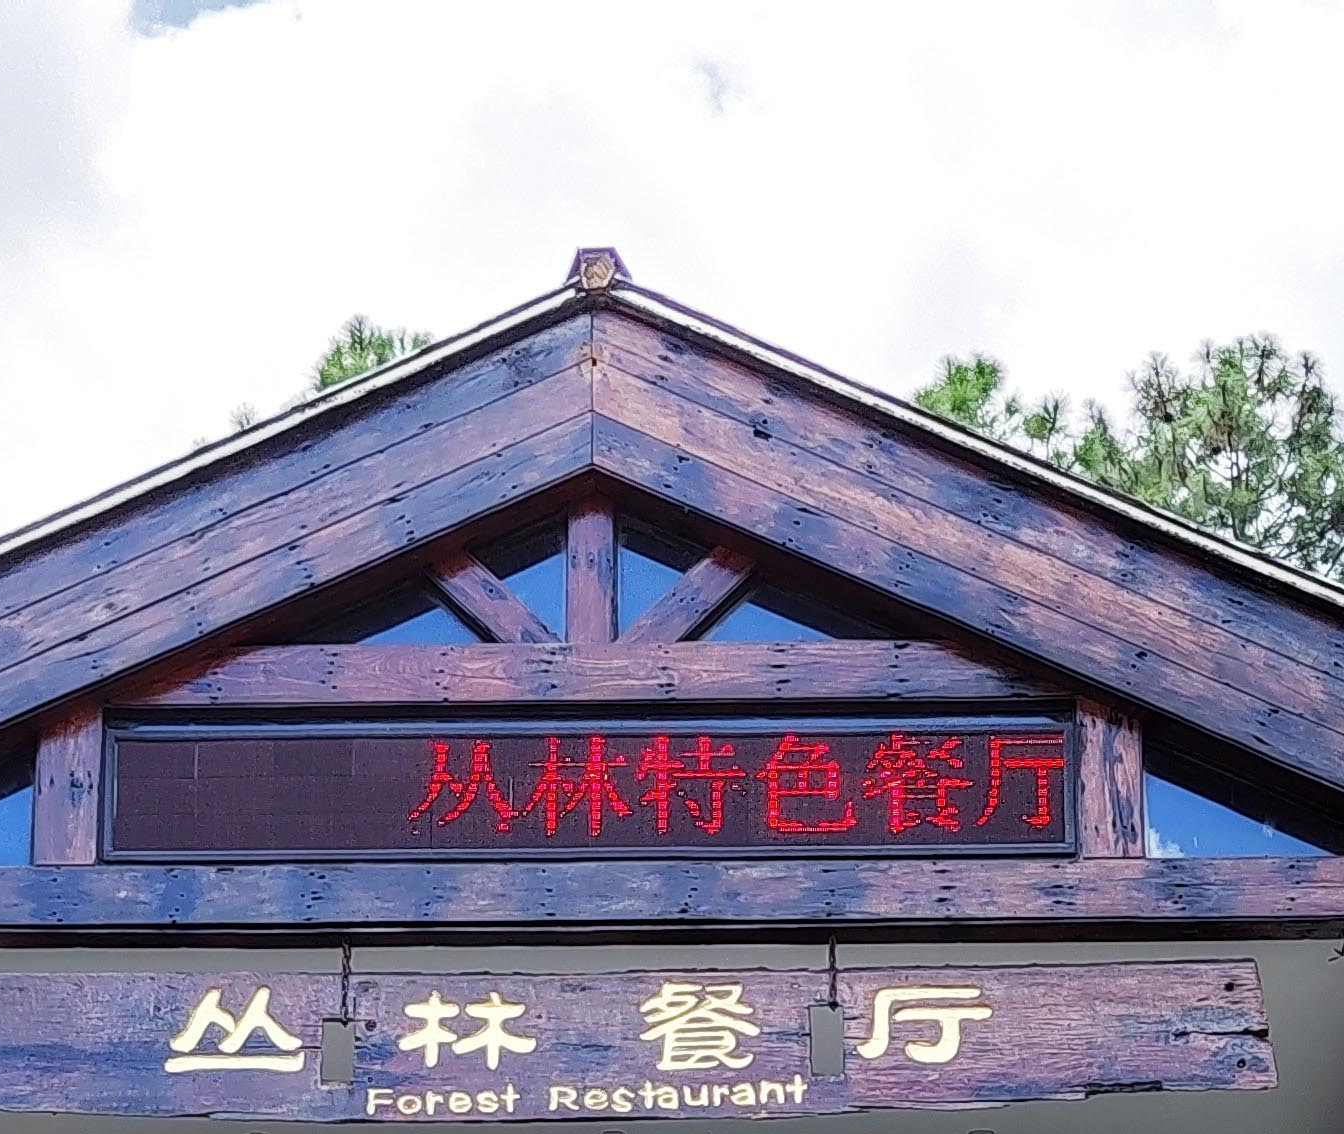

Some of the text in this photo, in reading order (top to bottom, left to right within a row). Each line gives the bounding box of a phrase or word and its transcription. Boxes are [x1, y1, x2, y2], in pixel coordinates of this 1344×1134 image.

[163, 980, 994, 1074] 丛林餐厅
[365, 1073, 809, 1117] Forest Restaurant
